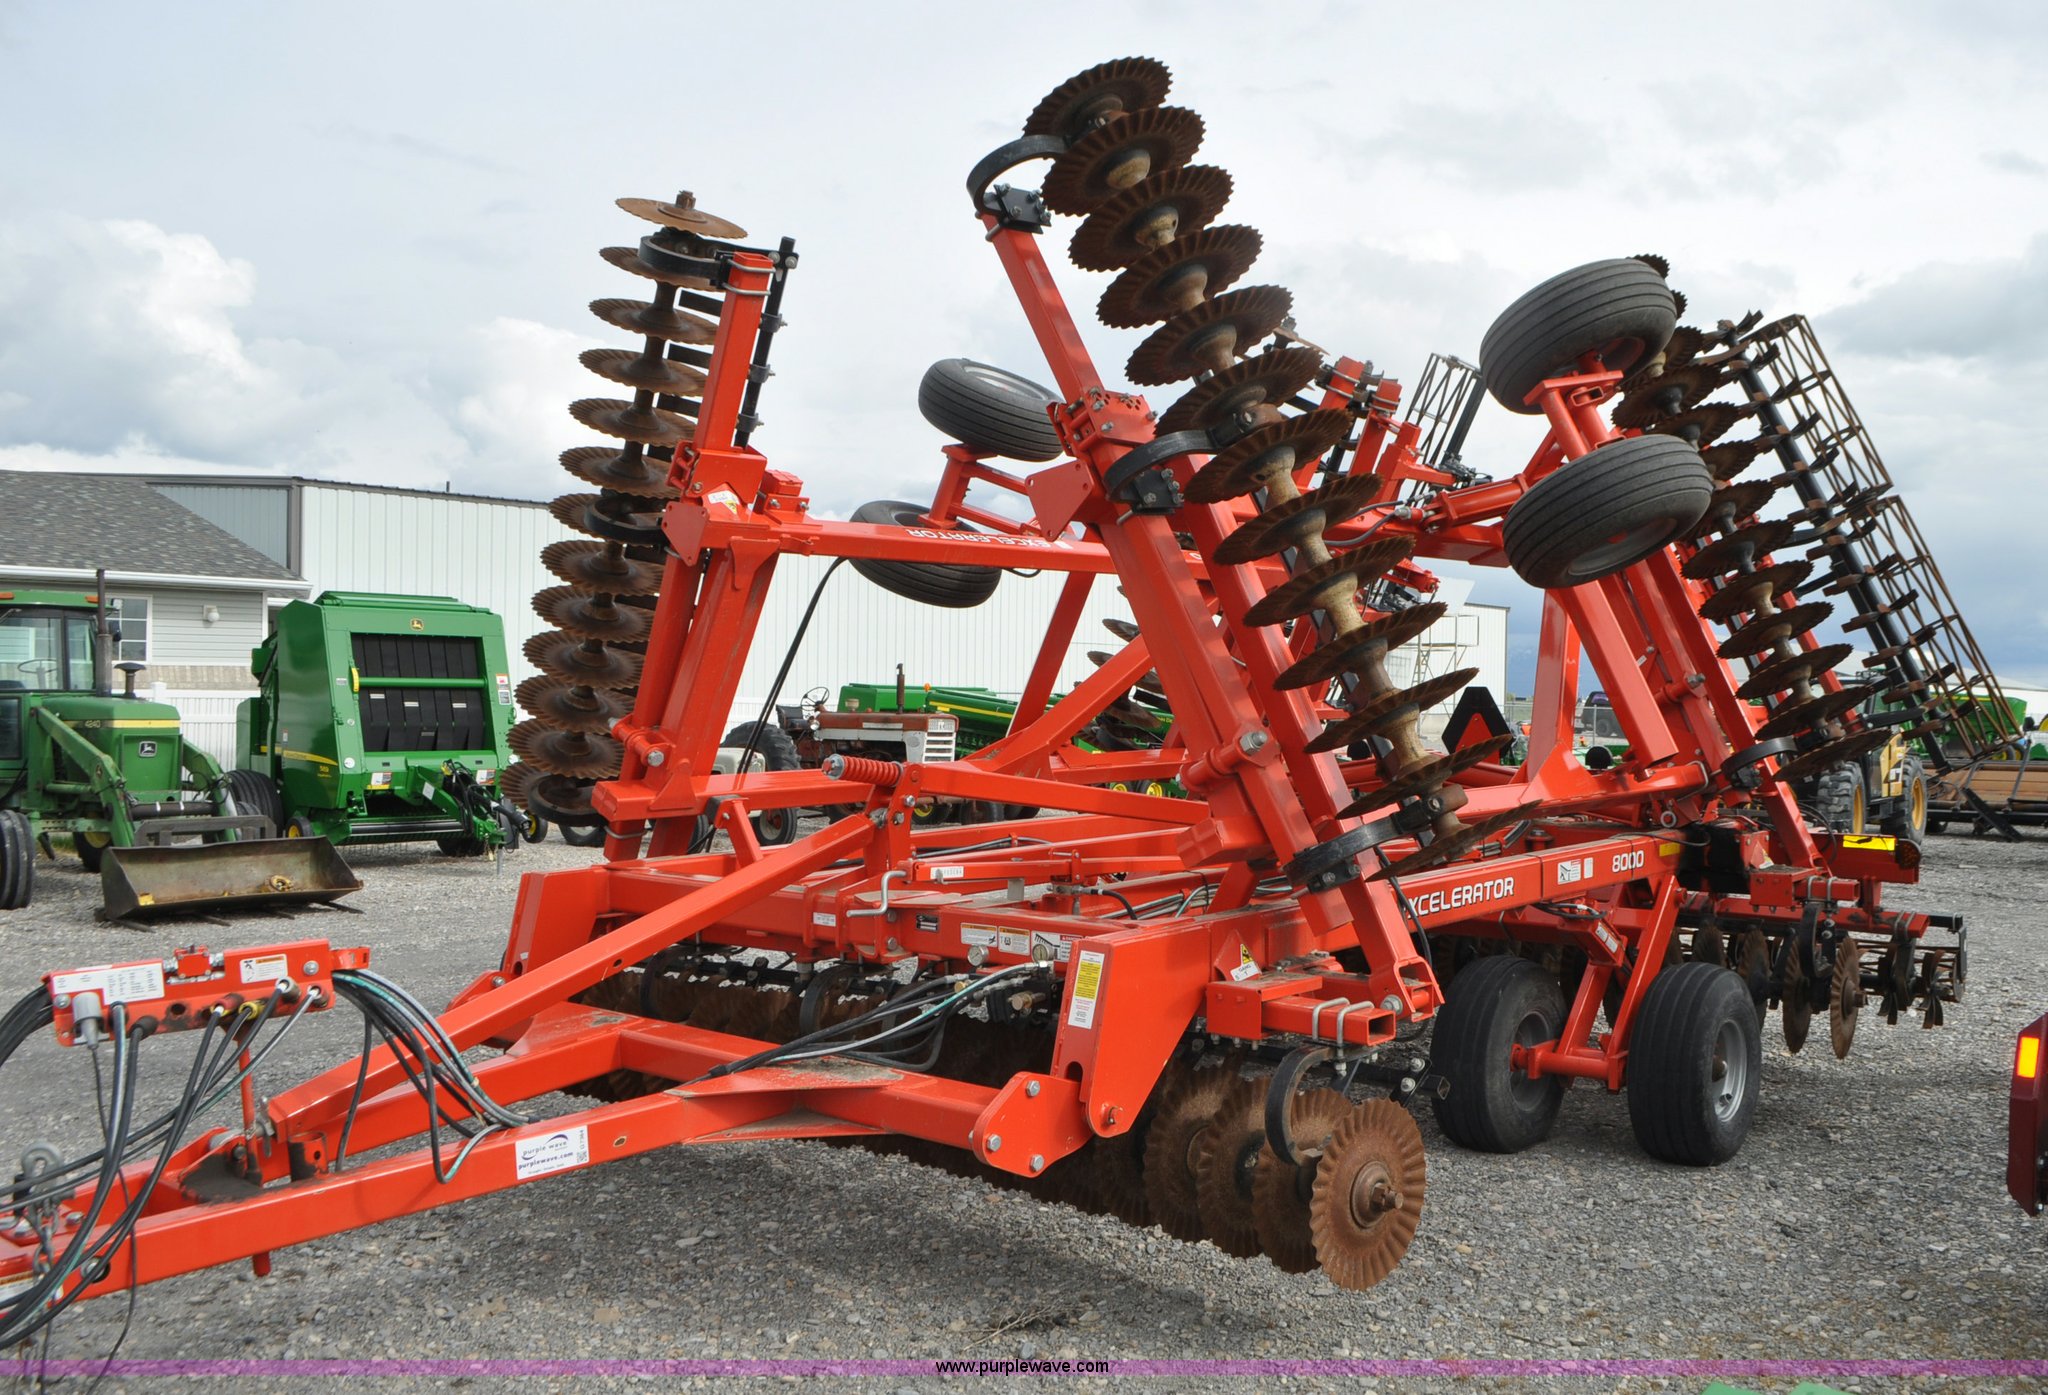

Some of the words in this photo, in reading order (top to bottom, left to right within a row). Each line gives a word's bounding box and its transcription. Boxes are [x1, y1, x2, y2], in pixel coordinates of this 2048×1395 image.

[1612, 850, 1644, 873] 8000
[1404, 877, 1514, 919] XCELERATOR
[522, 1146, 546, 1156] purple
[548, 1141, 567, 1149] wave
[518, 1151, 574, 1170] purplewave.com
